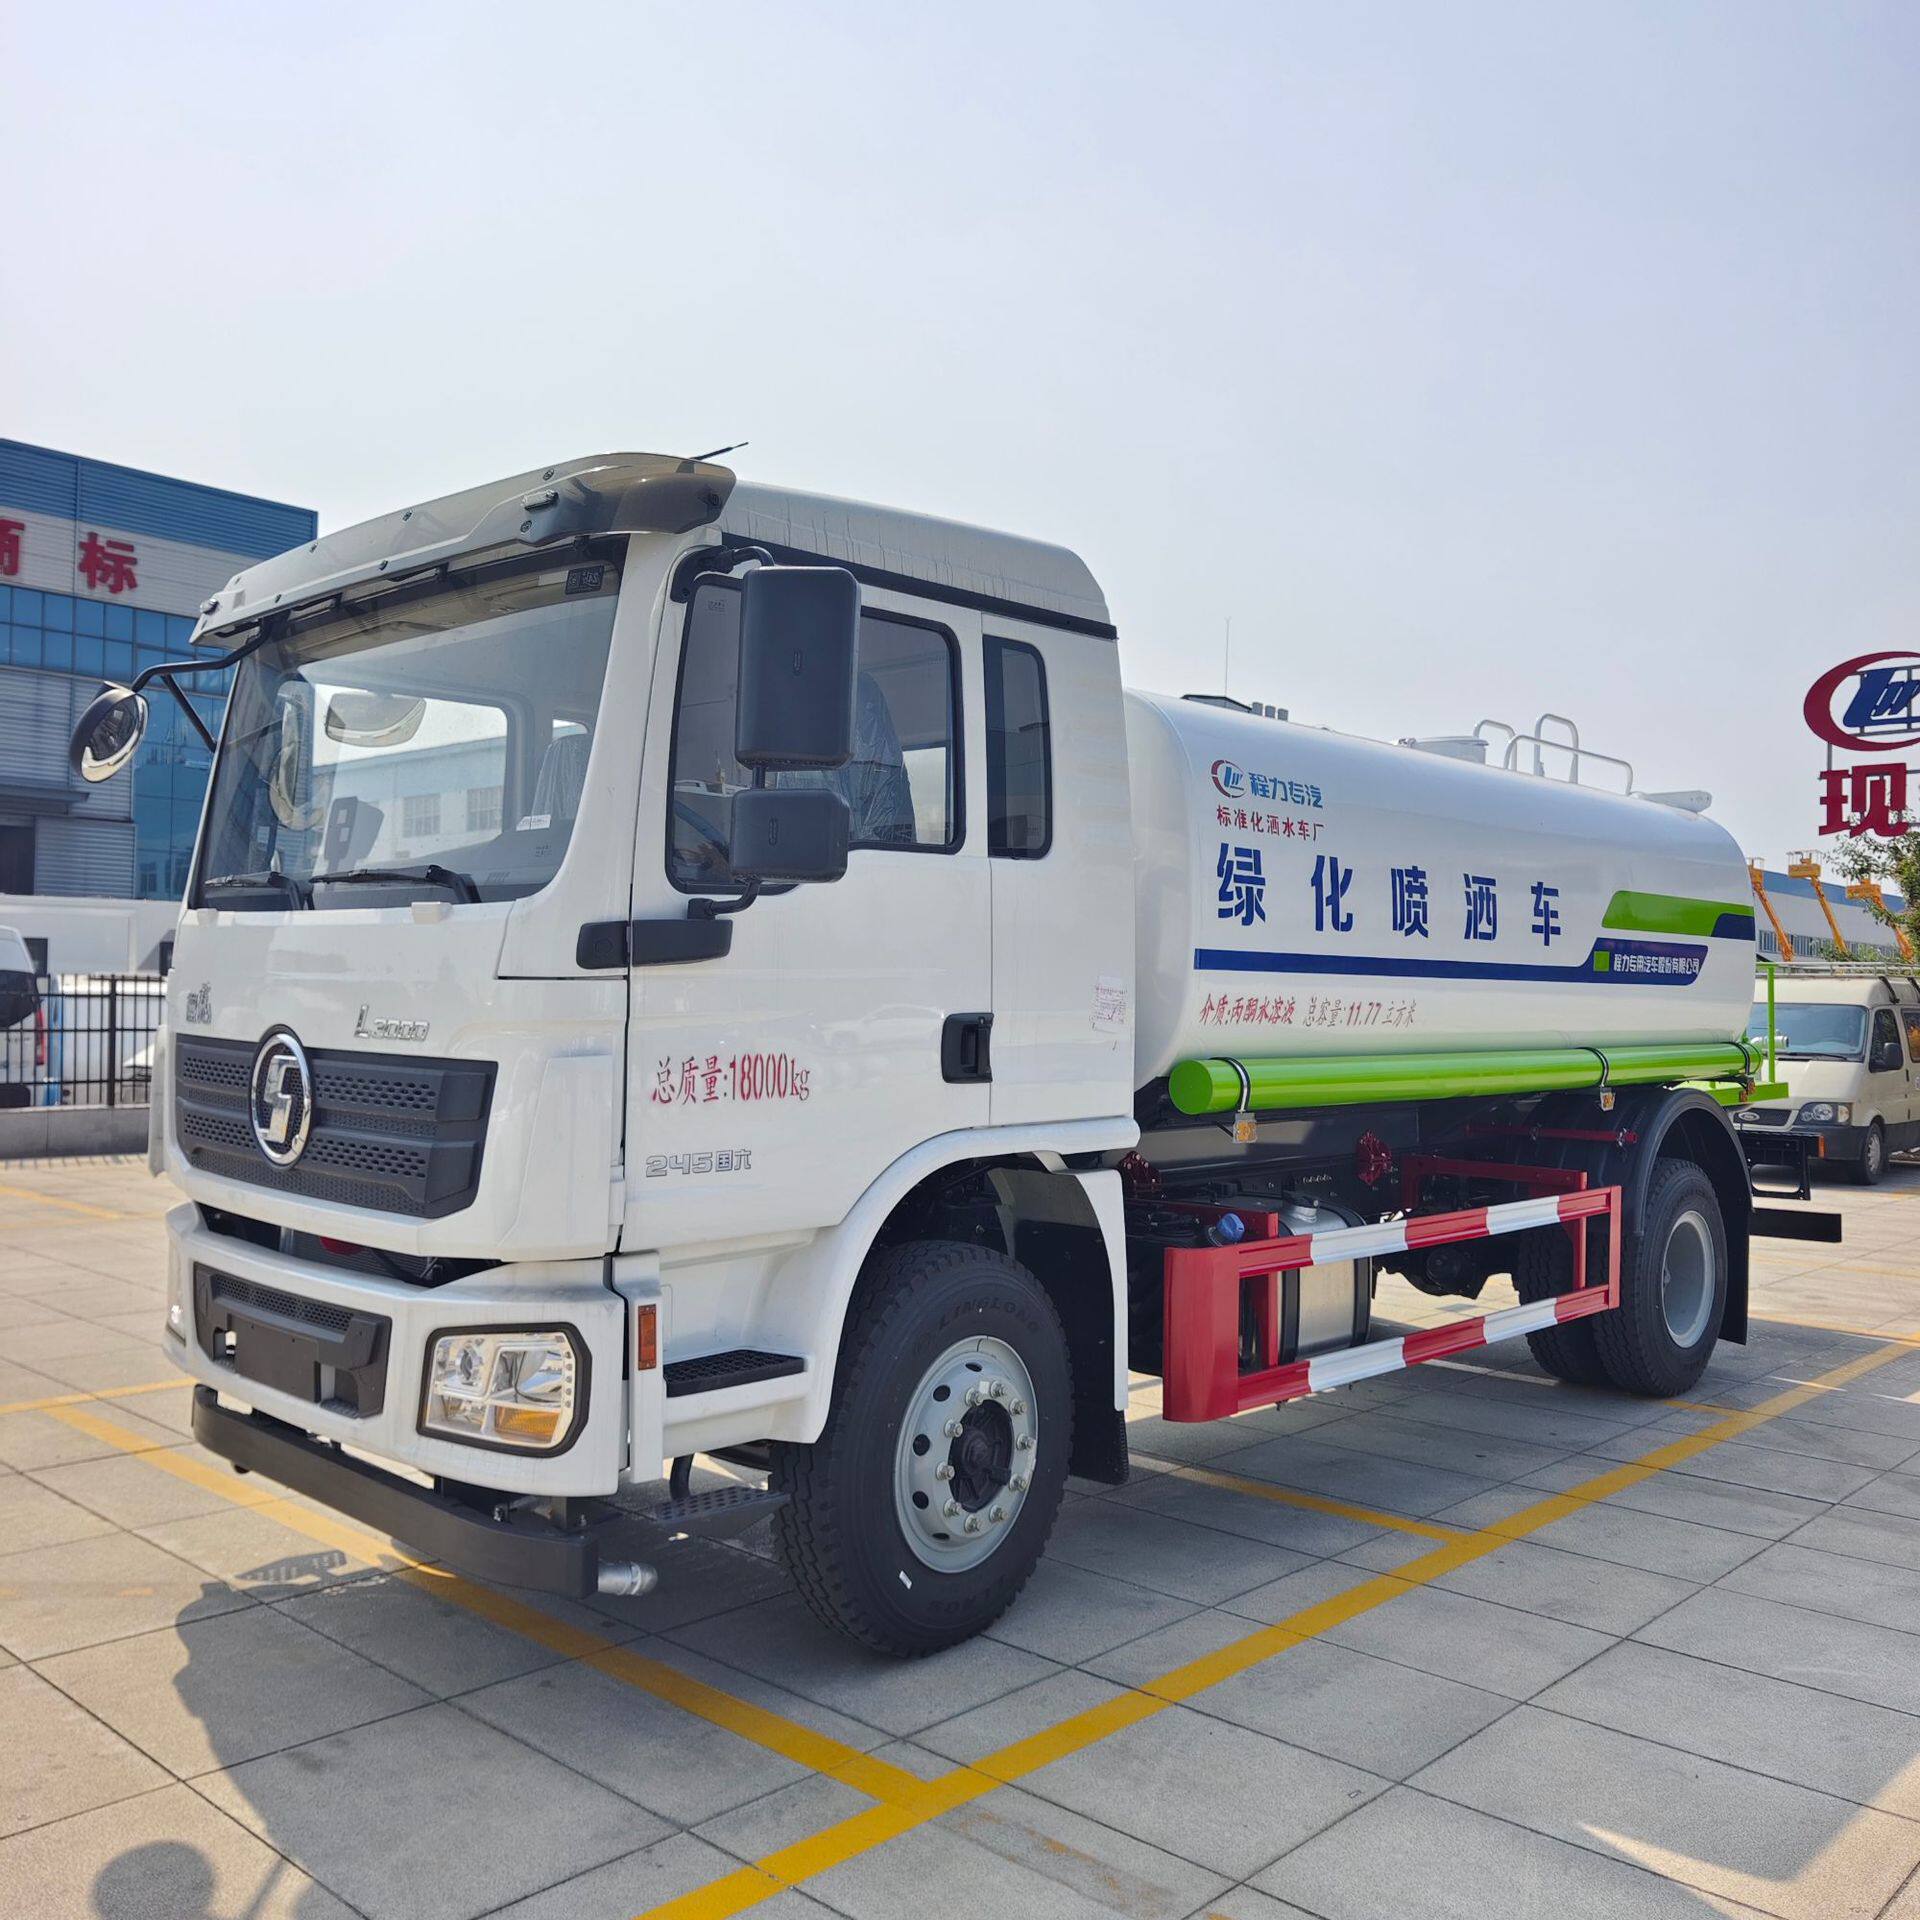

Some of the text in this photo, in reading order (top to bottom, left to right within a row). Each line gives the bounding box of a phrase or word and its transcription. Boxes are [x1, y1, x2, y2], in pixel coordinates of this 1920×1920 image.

[1248, 771, 1324, 809] 程力专汽
[1216, 804, 1325, 841] 标准化洒水车厂
[1217, 842, 1561, 947] 绿化喷洒车
